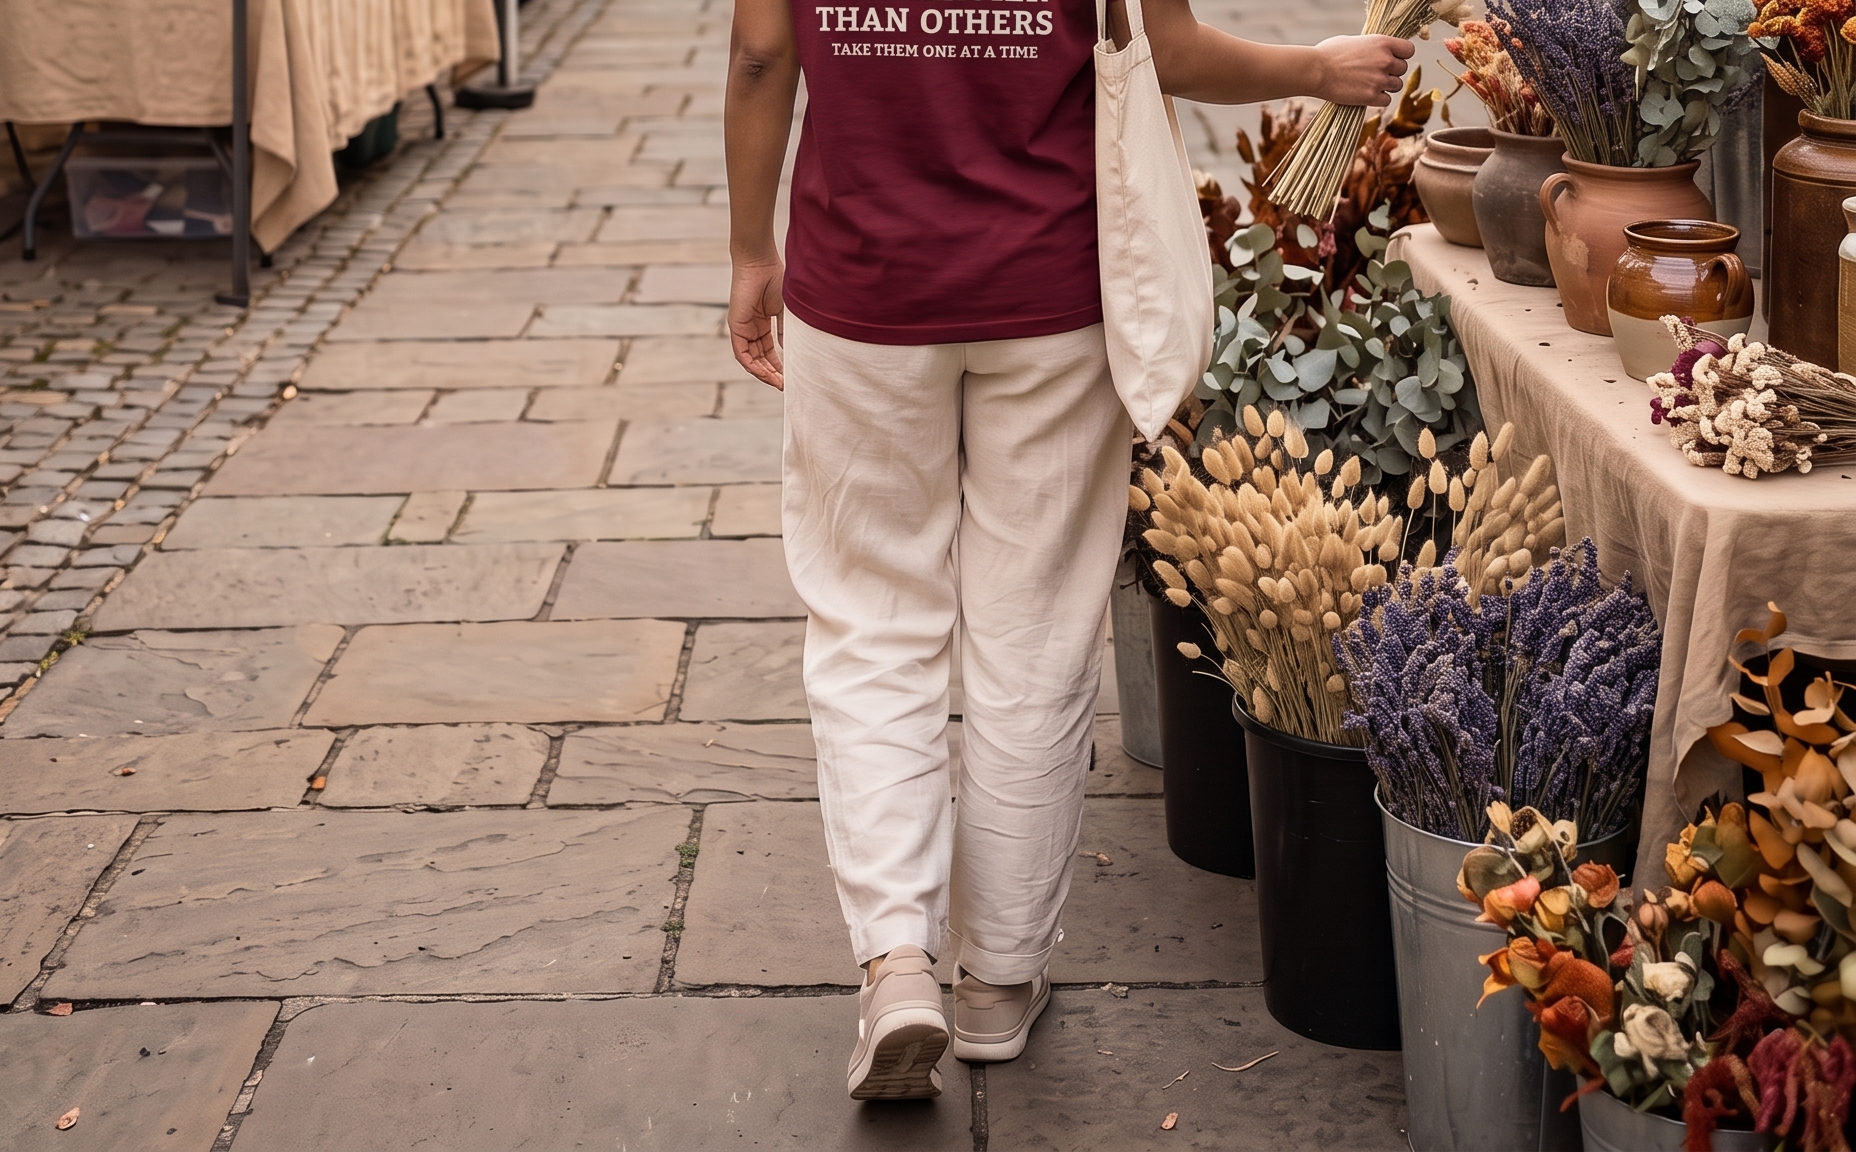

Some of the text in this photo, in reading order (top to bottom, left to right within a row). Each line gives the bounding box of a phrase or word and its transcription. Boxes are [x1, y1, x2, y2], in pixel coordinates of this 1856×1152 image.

[816, 7, 1052, 35] THAN OTHERS
[832, 43, 1037, 58] TAKE THEM ONE AT A TIME
